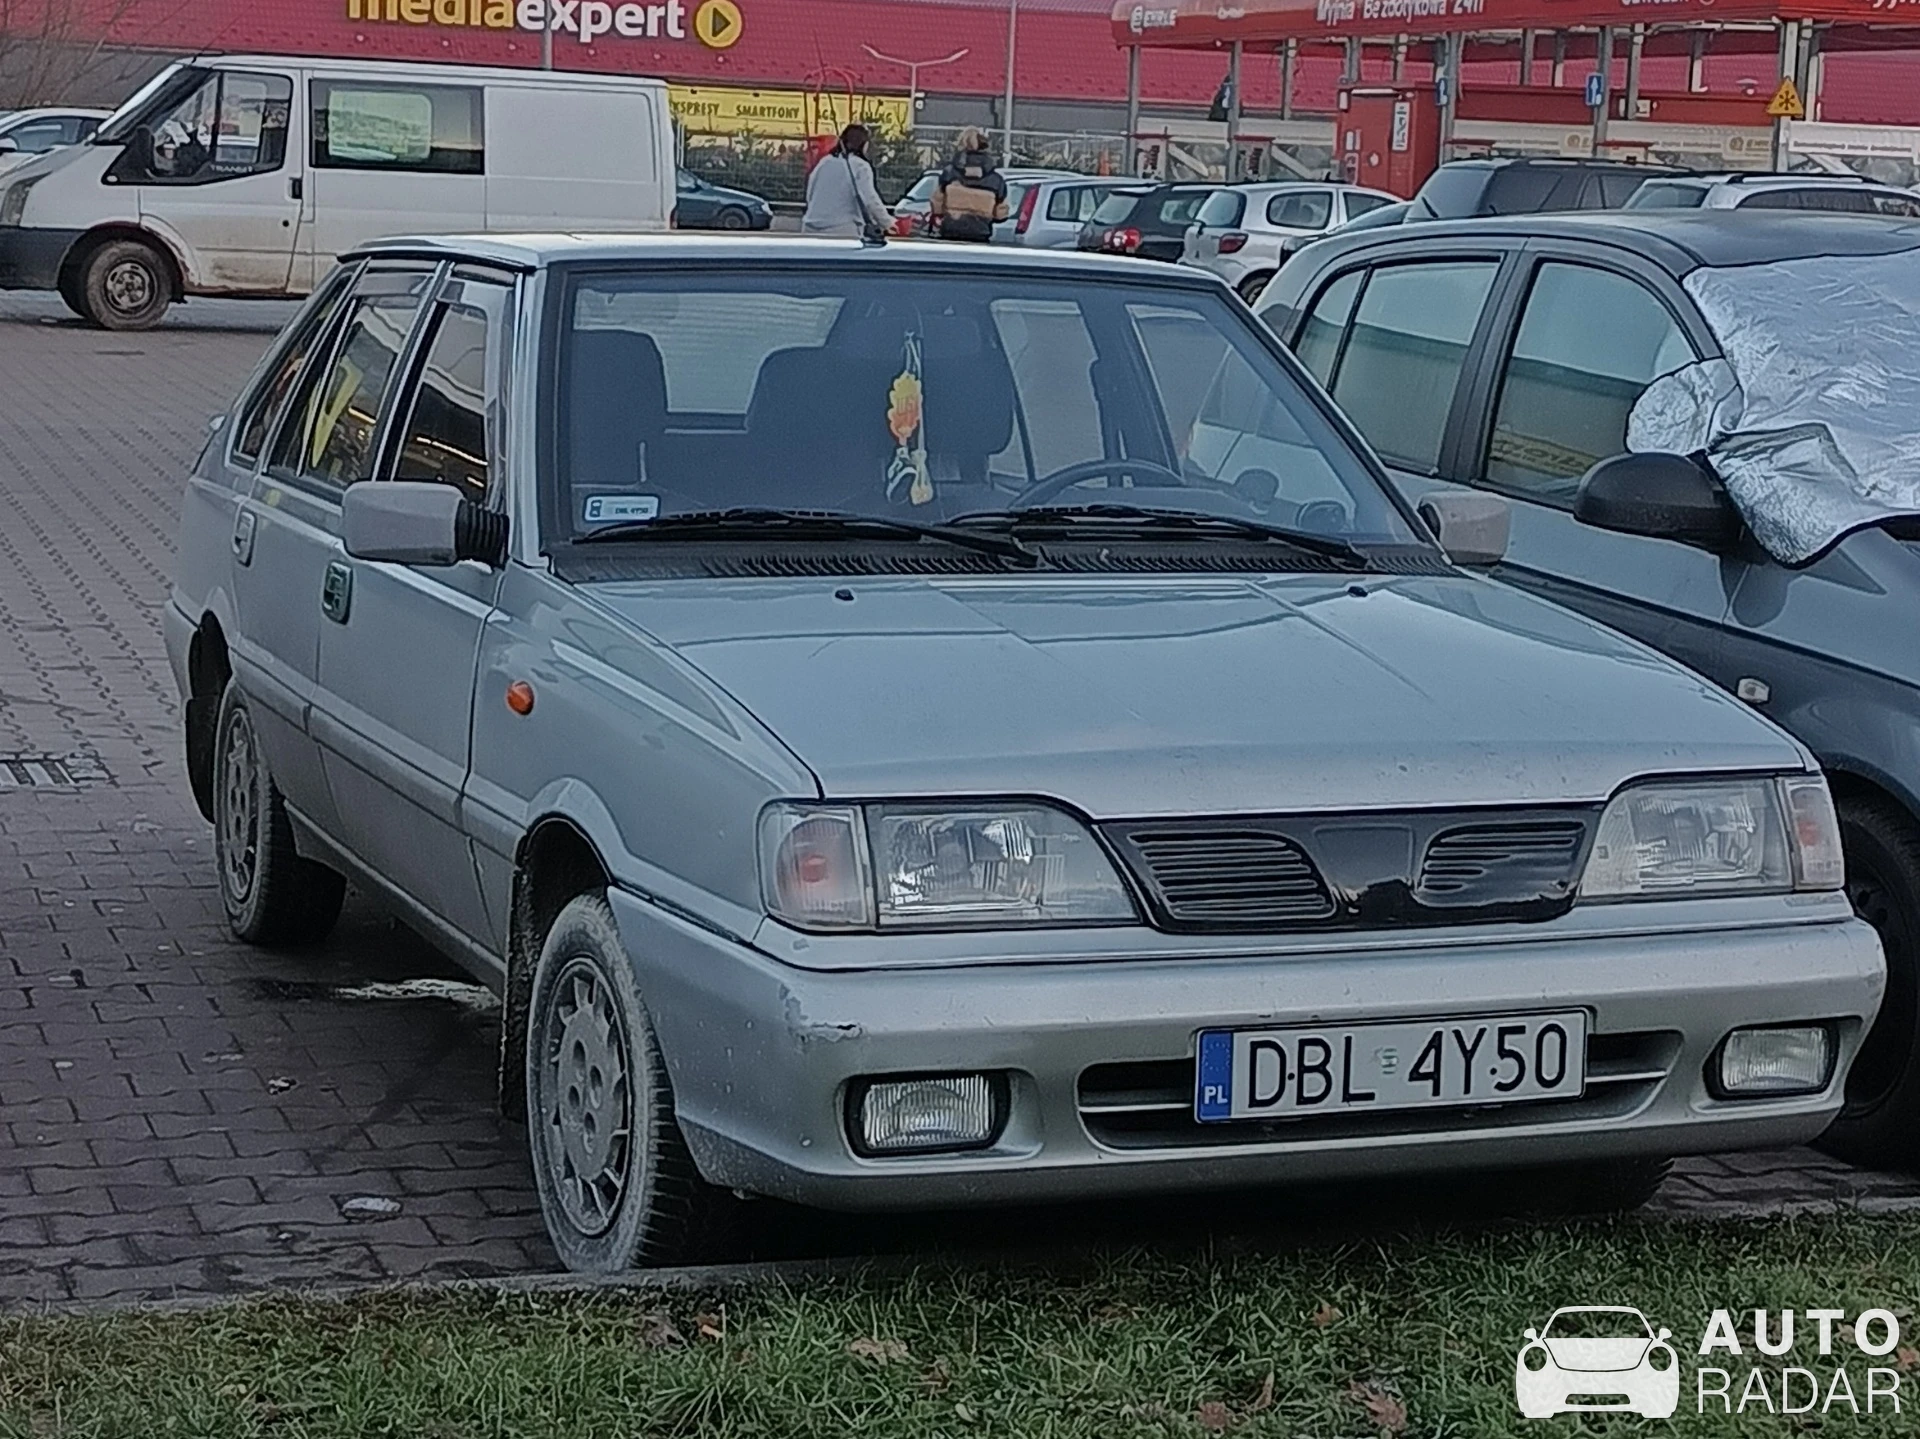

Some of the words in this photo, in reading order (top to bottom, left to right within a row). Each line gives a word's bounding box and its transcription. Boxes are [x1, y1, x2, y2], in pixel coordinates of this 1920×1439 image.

[349, 0, 685, 43] mediaexpert
[736, 104, 800, 119] SMARTFONY
[1248, 1035, 1376, 1109] DBL
[1408, 1023, 1568, 1098] 4Y50
[1204, 1085, 1228, 1105] PL
